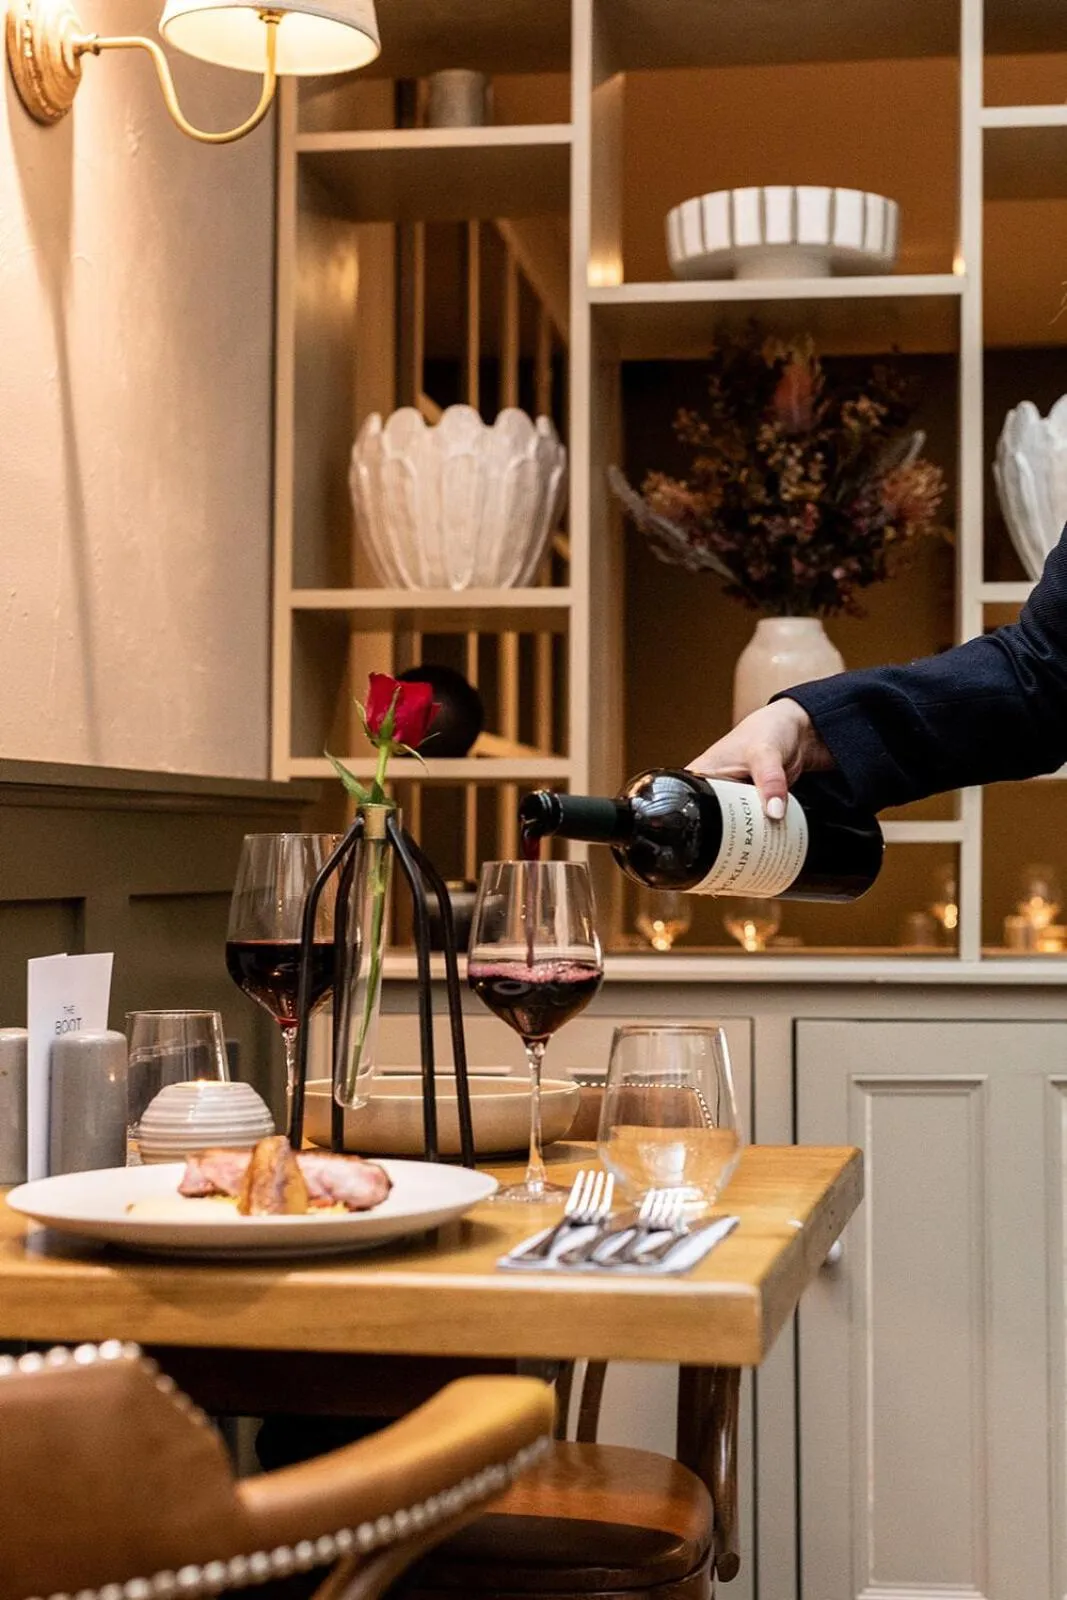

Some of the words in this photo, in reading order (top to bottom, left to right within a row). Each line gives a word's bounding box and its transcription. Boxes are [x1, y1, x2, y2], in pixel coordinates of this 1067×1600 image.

[739, 796, 754, 848] RANCH
[62, 1004, 76, 1015] THE
[54, 1017, 83, 1036] BOOT
